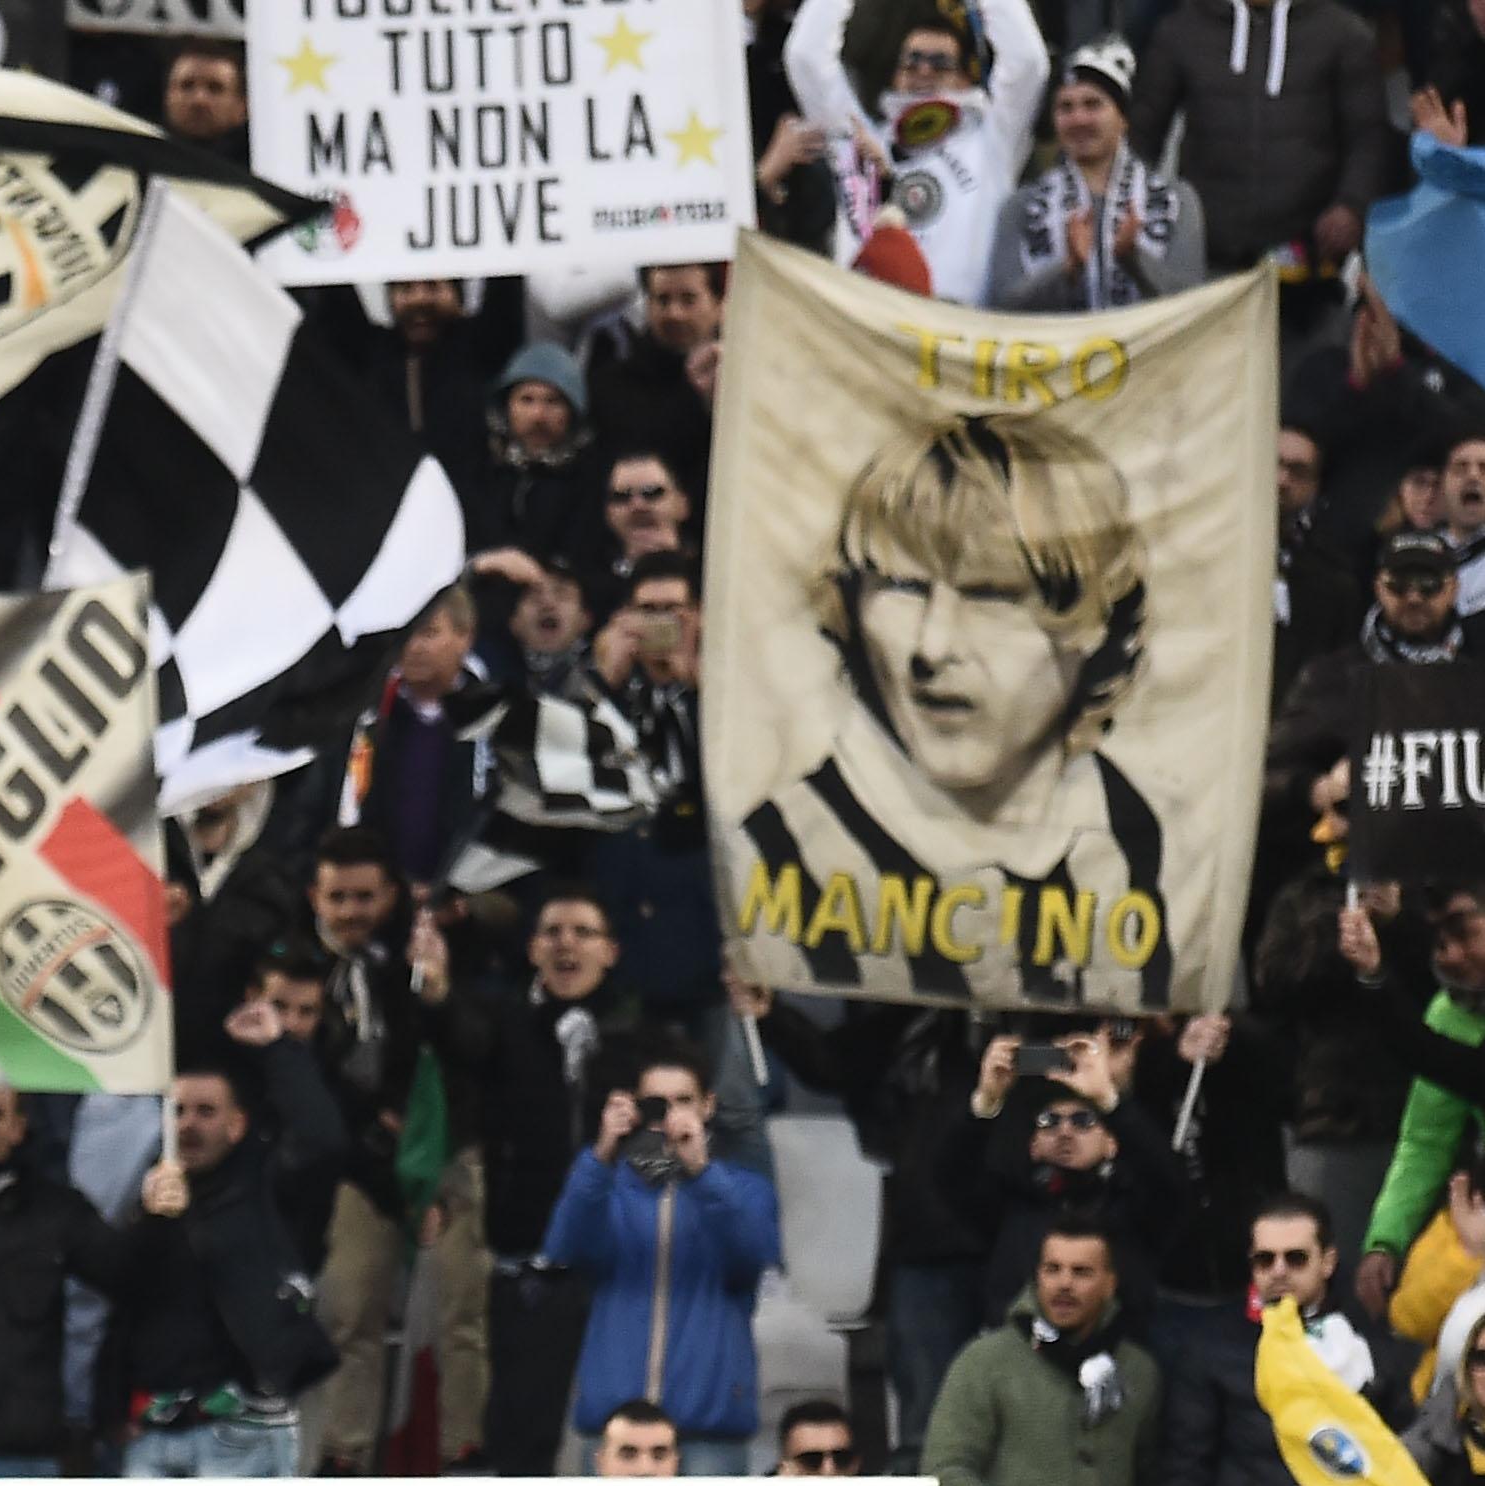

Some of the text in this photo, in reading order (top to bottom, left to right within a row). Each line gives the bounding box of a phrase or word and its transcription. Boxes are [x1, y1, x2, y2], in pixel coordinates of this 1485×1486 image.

[382, 21, 572, 95] TUTTO
[307, 94, 656, 175] MA NON LA
[407, 177, 562, 250] JUVE
[900, 322, 1131, 408] TIRO
[738, 860, 1162, 970] MANCINO
